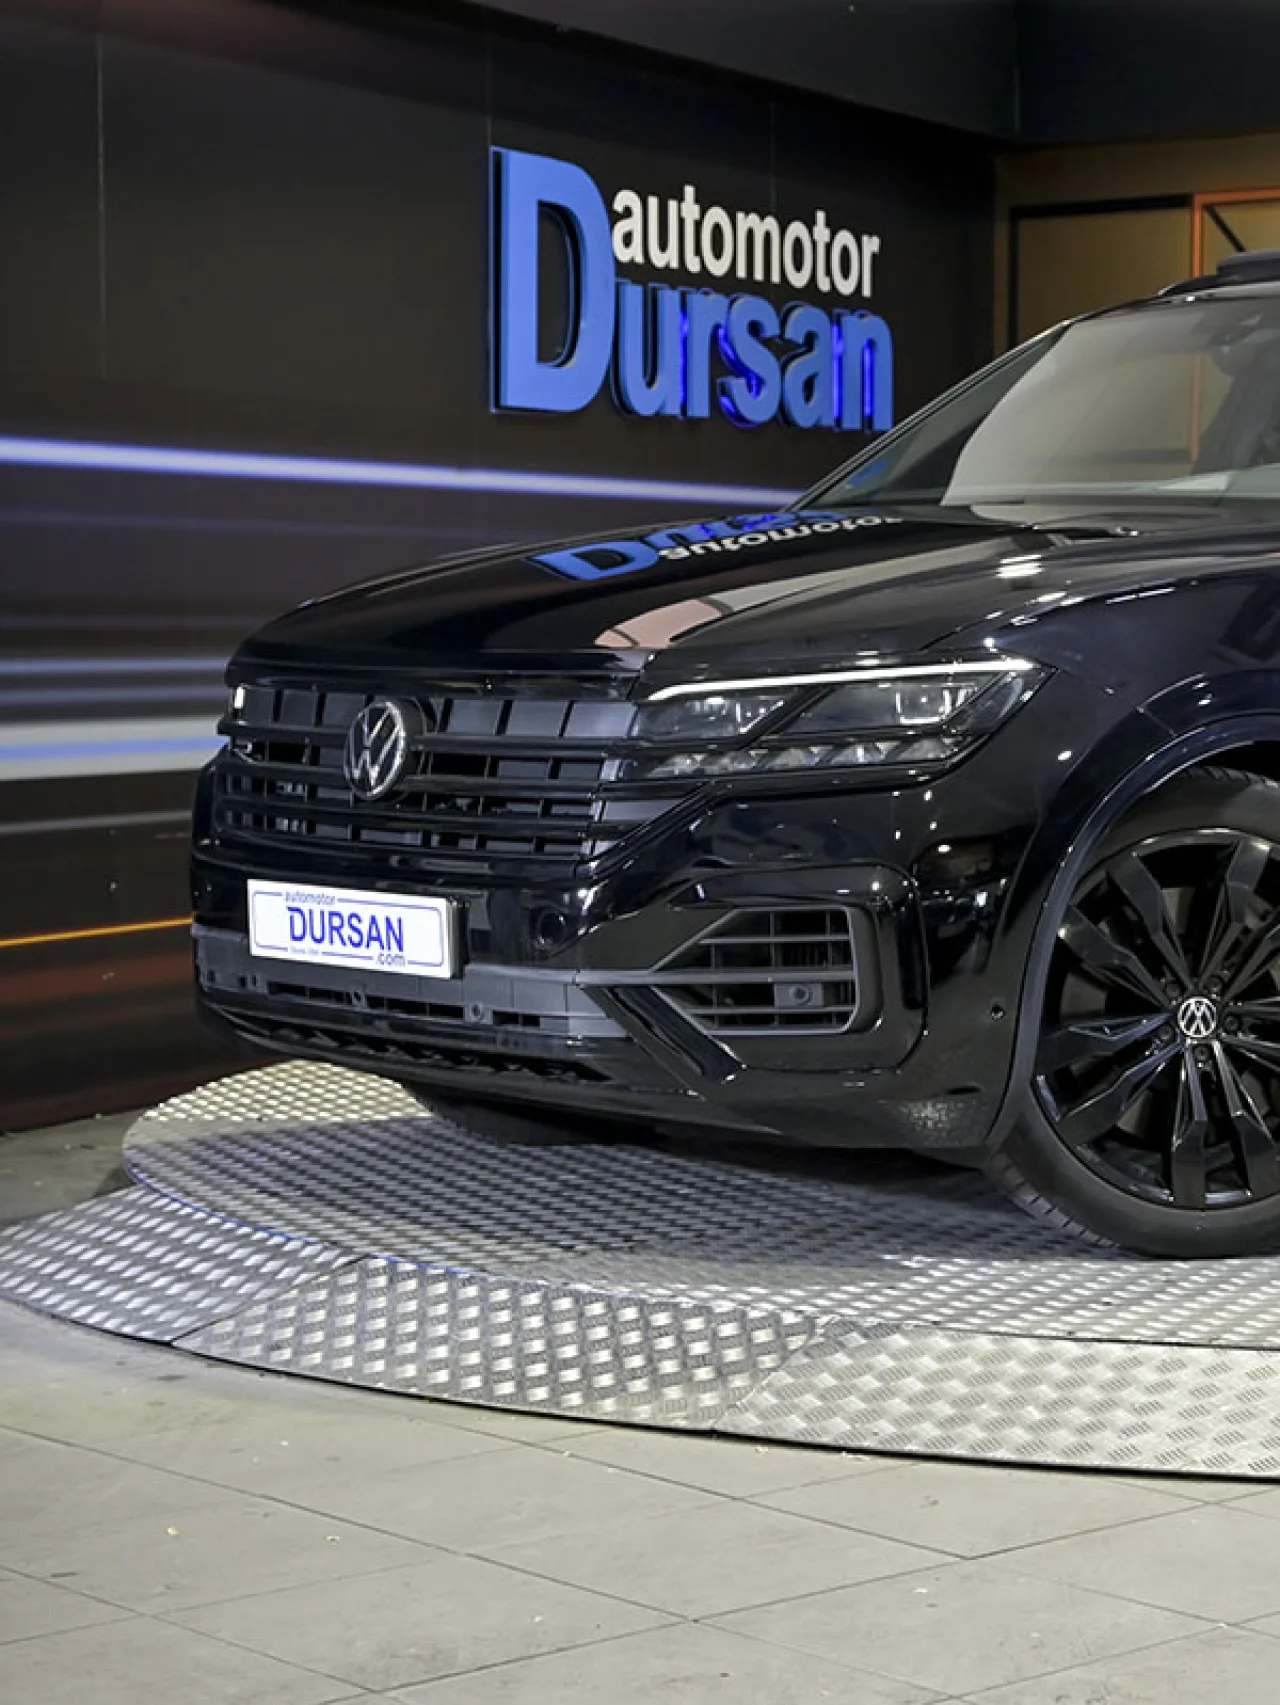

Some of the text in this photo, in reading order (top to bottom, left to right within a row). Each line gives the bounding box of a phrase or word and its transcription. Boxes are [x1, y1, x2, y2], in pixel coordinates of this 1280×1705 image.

[490, 146, 894, 433] Dursan
[612, 185, 881, 298] automotor
[287, 906, 404, 952] DURSAN
